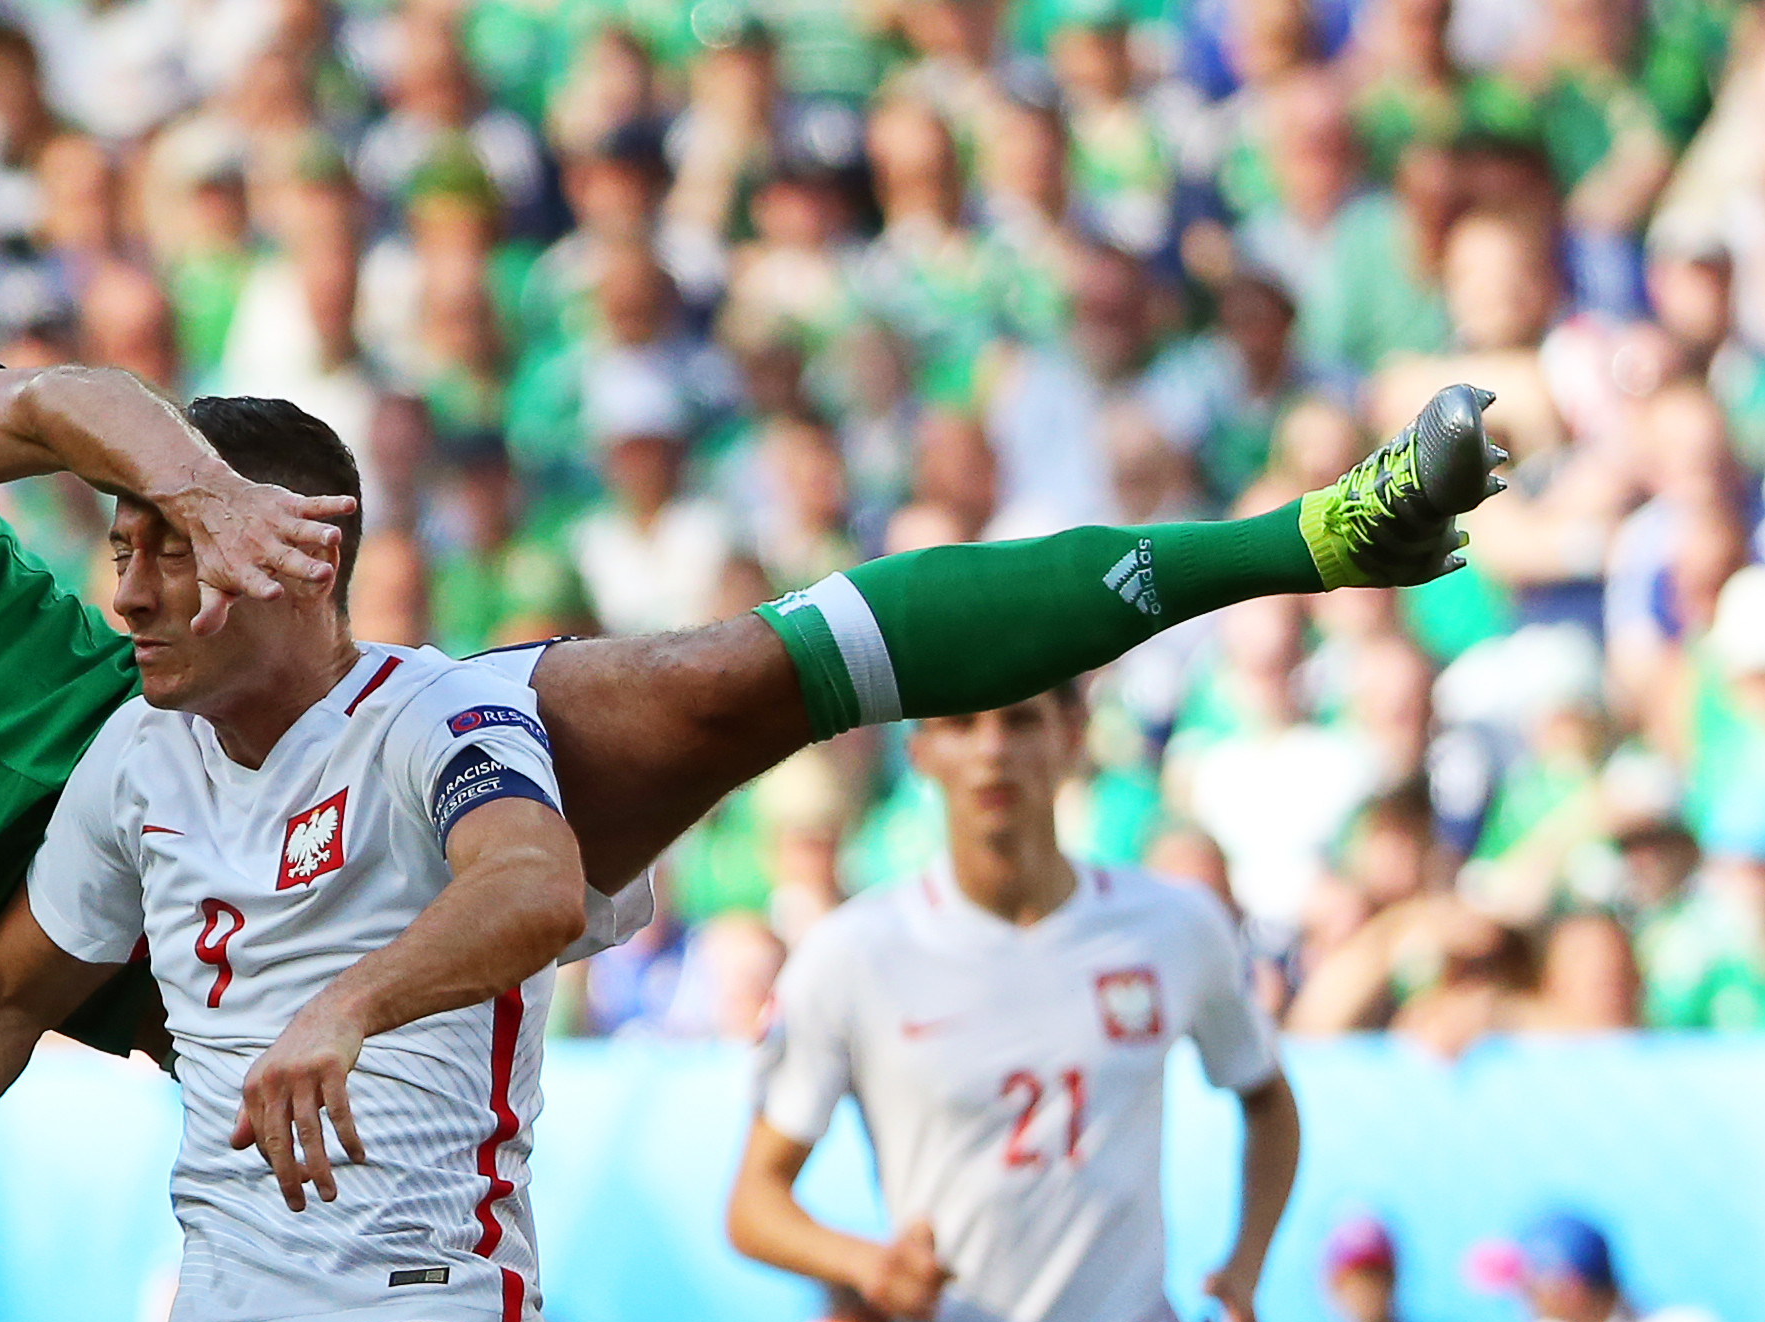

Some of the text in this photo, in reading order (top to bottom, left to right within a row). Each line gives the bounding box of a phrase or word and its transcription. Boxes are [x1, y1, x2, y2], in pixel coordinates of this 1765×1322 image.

[1137, 538, 1162, 615] adidas
[446, 761, 508, 795] RACISM
[194, 897, 246, 1008] 9
[998, 1066, 1087, 1169] 21
